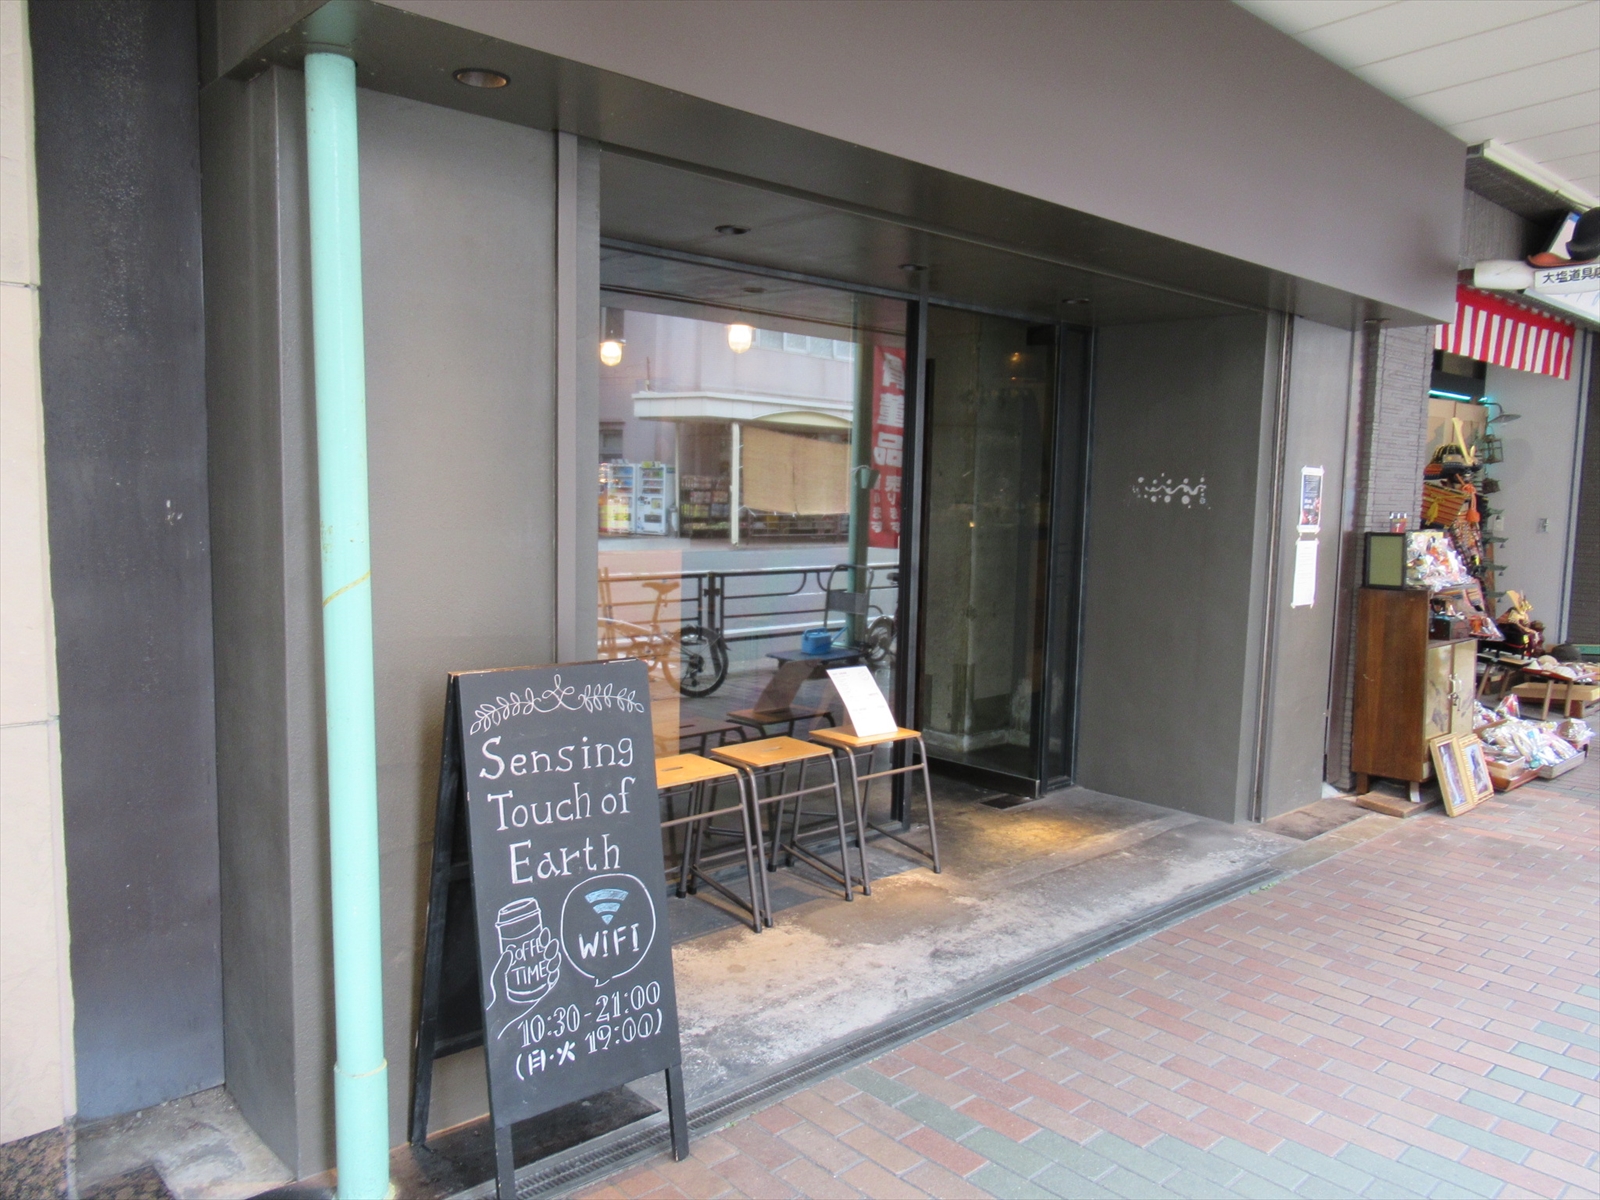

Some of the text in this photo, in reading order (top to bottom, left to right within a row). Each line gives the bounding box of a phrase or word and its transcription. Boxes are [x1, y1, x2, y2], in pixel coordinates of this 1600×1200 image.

[479, 735, 634, 780] Sensing
[487, 777, 636, 831] Touch of
[509, 834, 621, 884] Earth
[511, 960, 548, 986] TIME
